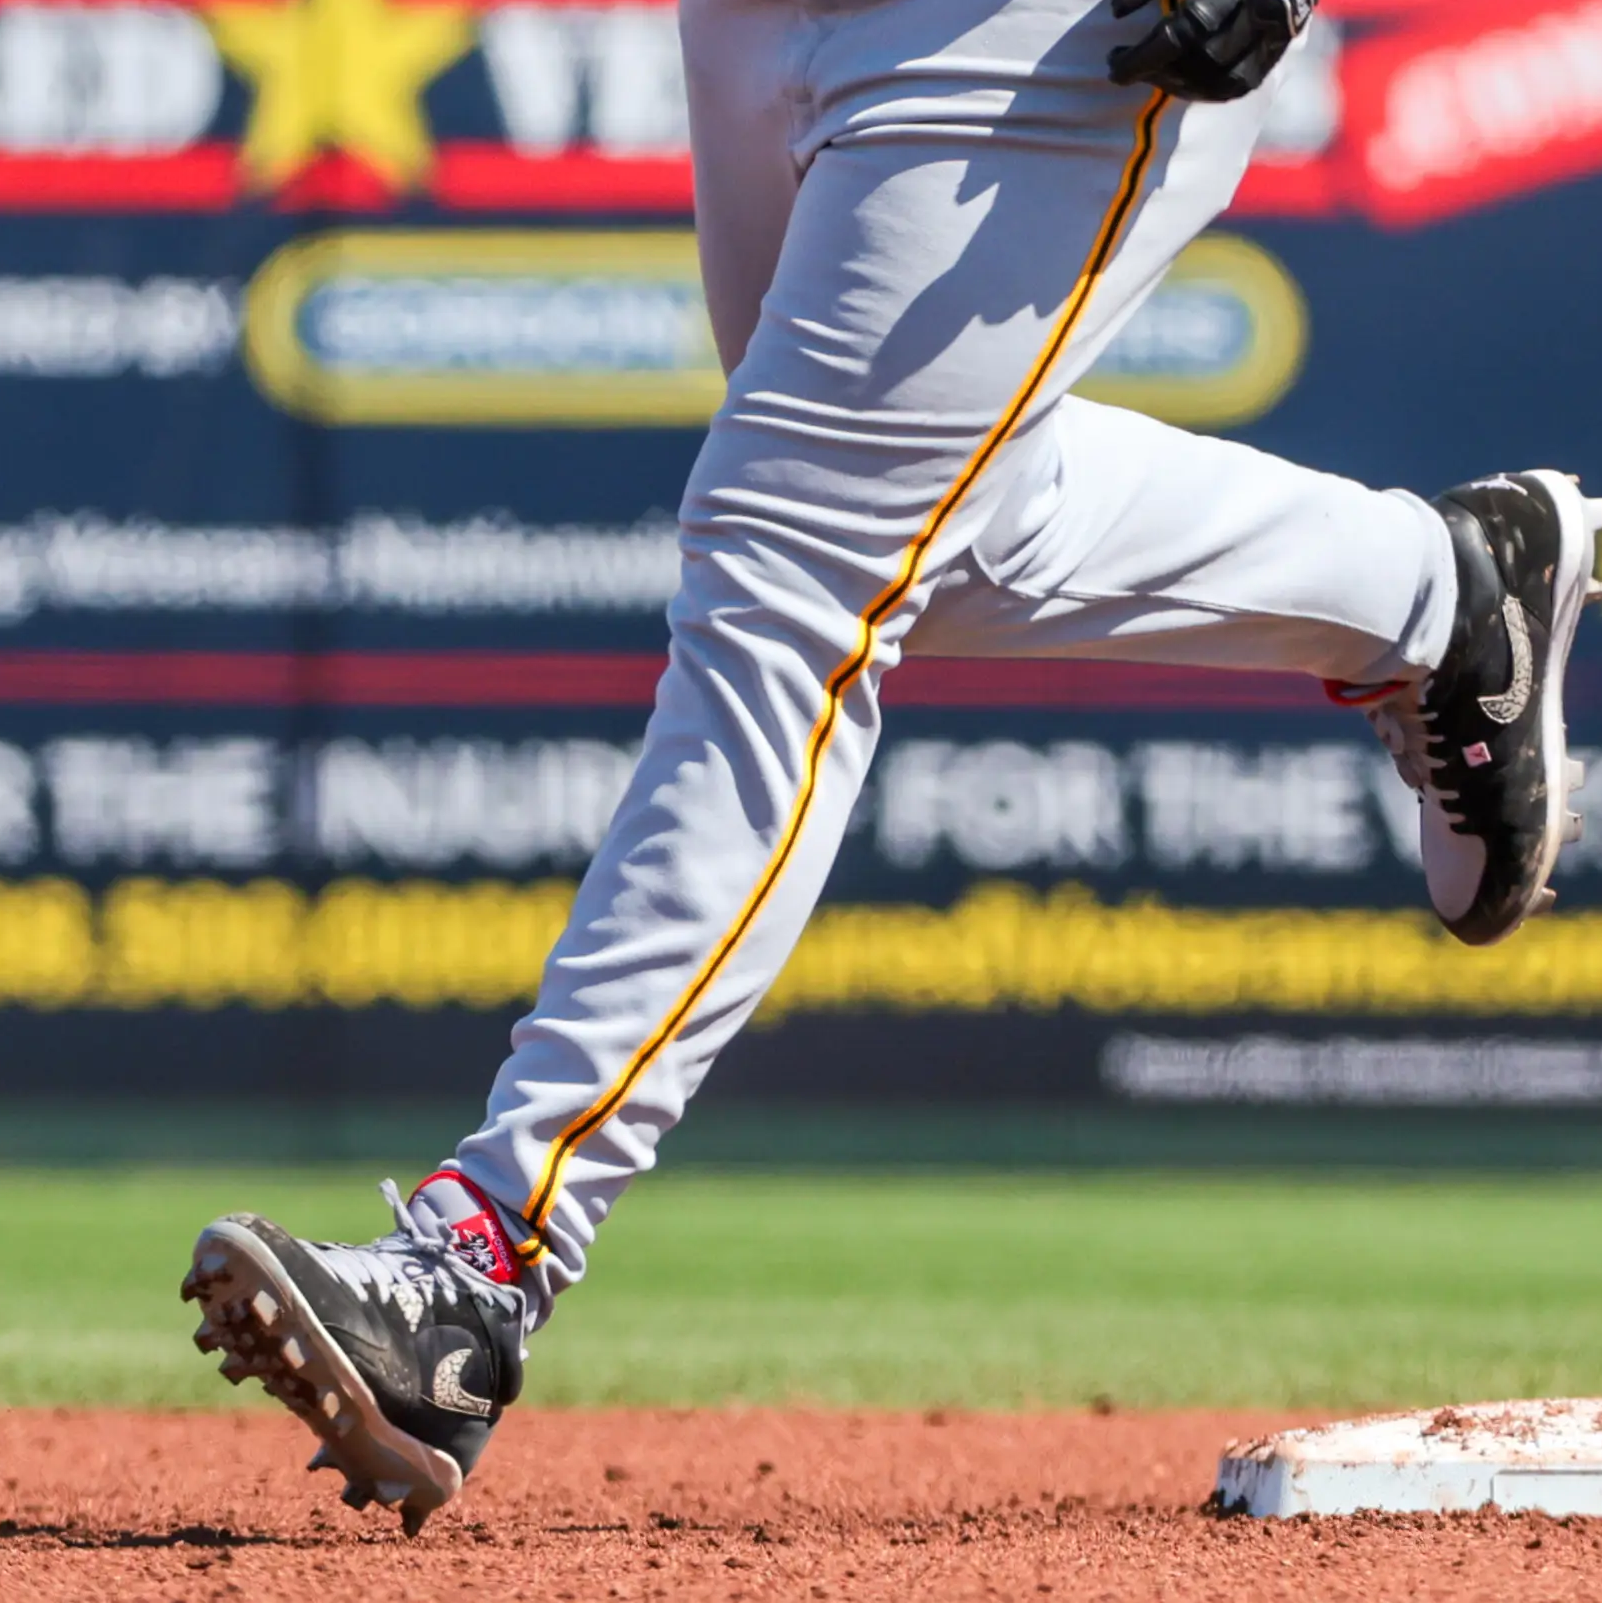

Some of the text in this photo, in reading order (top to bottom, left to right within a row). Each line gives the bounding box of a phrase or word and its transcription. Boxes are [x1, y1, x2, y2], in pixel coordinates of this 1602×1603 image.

[45, 737, 272, 866] THE
[878, 740, 1132, 871] FOR
[1140, 740, 1371, 871] THE
